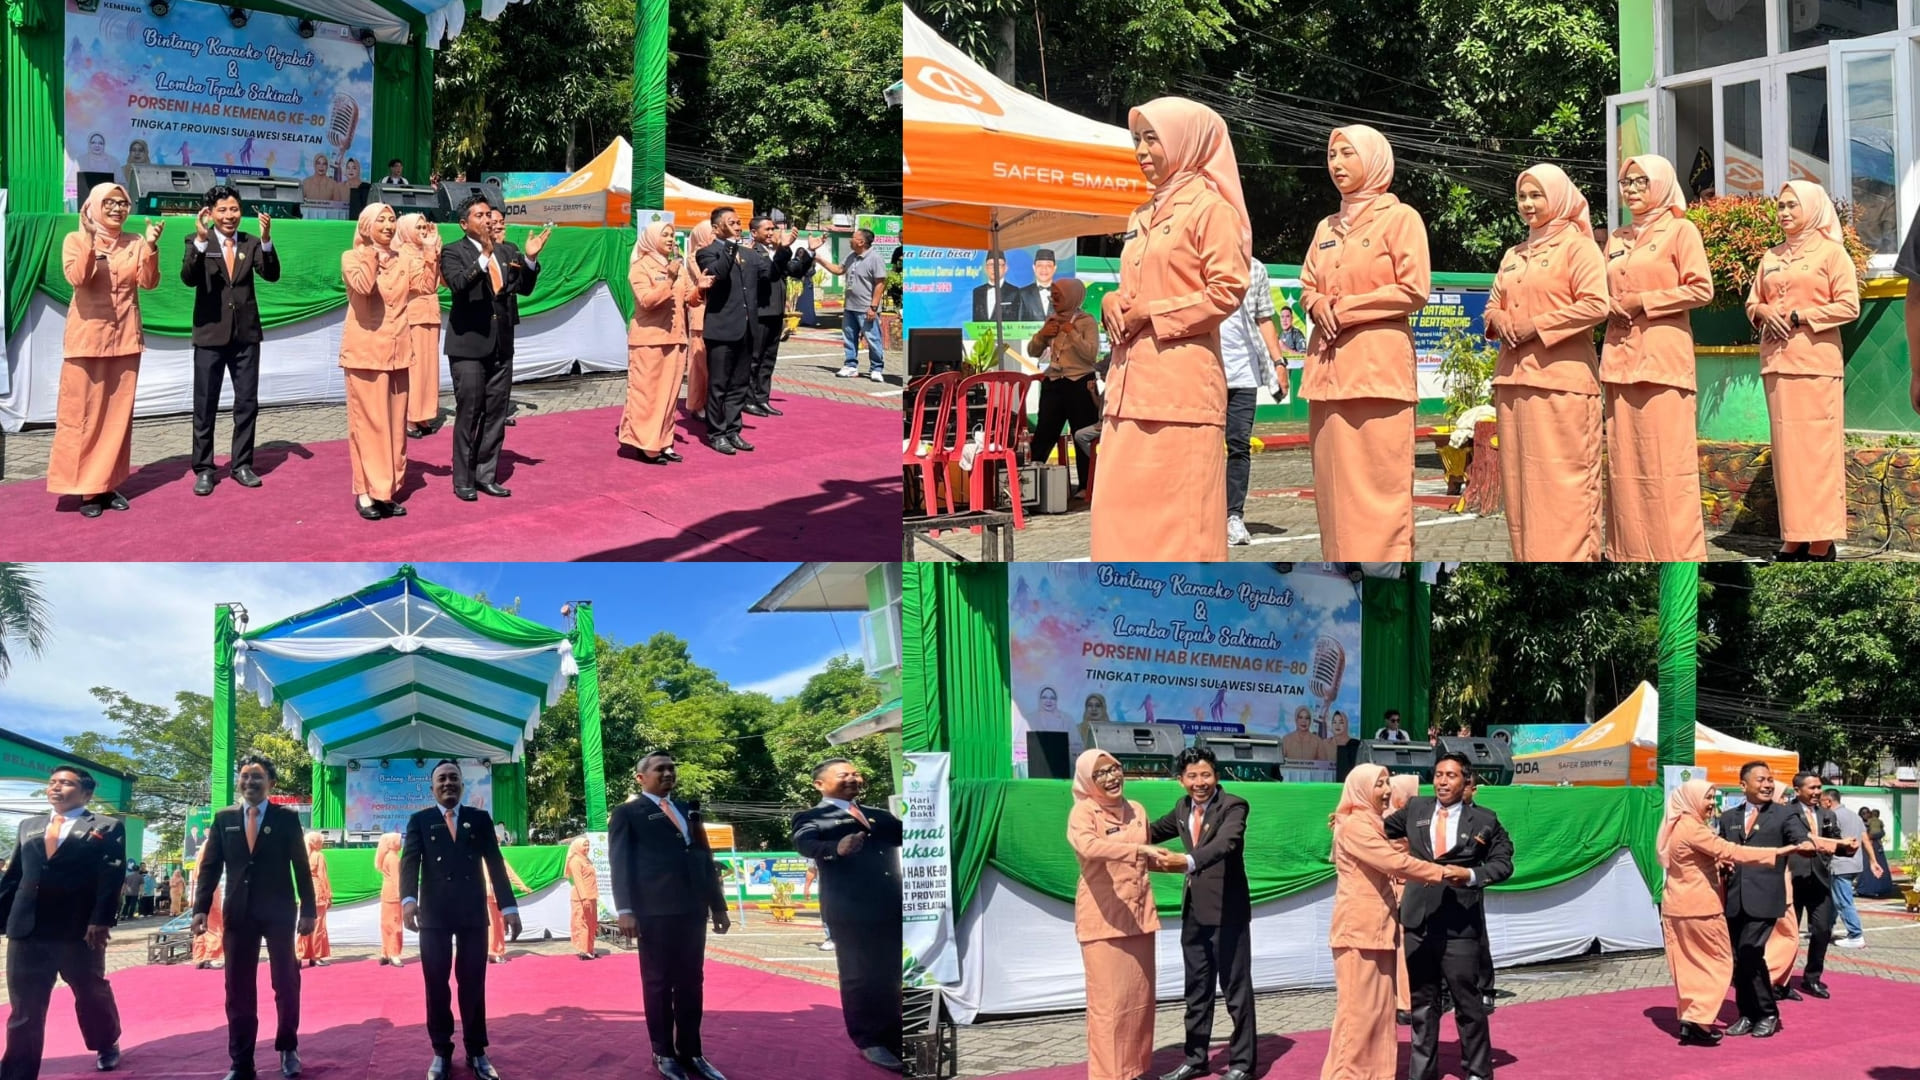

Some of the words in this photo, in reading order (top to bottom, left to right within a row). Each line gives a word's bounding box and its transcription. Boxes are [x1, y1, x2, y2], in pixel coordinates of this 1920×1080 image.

[144, 28, 202, 57] Bintang
[206, 36, 262, 60] Karaoke
[265, 45, 314, 70] Pejabat
[228, 60, 238, 78] &
[156, 72, 206, 94] Lomba
[206, 78, 246, 102] Tepuk
[249, 84, 302, 104] Sakinah
[128, 94, 188, 112] PORSENI
[192, 102, 220, 116] HAB
[223, 106, 286, 123] KEMENAG
[289, 112, 326, 127] KE-80
[130, 118, 179, 132] TINGKAT
[181, 124, 230, 136] PROVINSI
[232, 128, 280, 141] SULAWESI
[282, 134, 322, 144] SELATAN
[993, 162, 1064, 184] SAFER
[1072, 172, 1140, 193] SMART
[1420, 316, 1471, 328] BERTANDING
[1422, 305, 1456, 316] DATANG
[1098, 565, 1166, 597] Bintang
[1170, 574, 1232, 600] Karaoke
[1238, 584, 1294, 611] Pejabat
[1194, 600, 1208, 622] &
[1114, 616, 1170, 638] Lomba
[1172, 620, 1216, 649] Tepuk
[1219, 628, 1282, 650] Sakinah
[1082, 642, 1150, 662] PORSENI
[1154, 650, 1187, 665] HAB
[1190, 654, 1262, 672] KEMENAG
[1265, 660, 1308, 676] KE-80
[1086, 669, 1141, 683] TINGKAT
[1142, 674, 1198, 688] PROVINSI
[1200, 679, 1256, 692] SULAWESI
[1258, 684, 1304, 696] SELATAN
[1558, 761, 1578, 770] SAFER
[908, 866, 924, 878] HAB
[912, 880, 934, 890] TAHUN
[912, 890, 946, 900] PROVINSI
[918, 901, 946, 910] SELATAN
